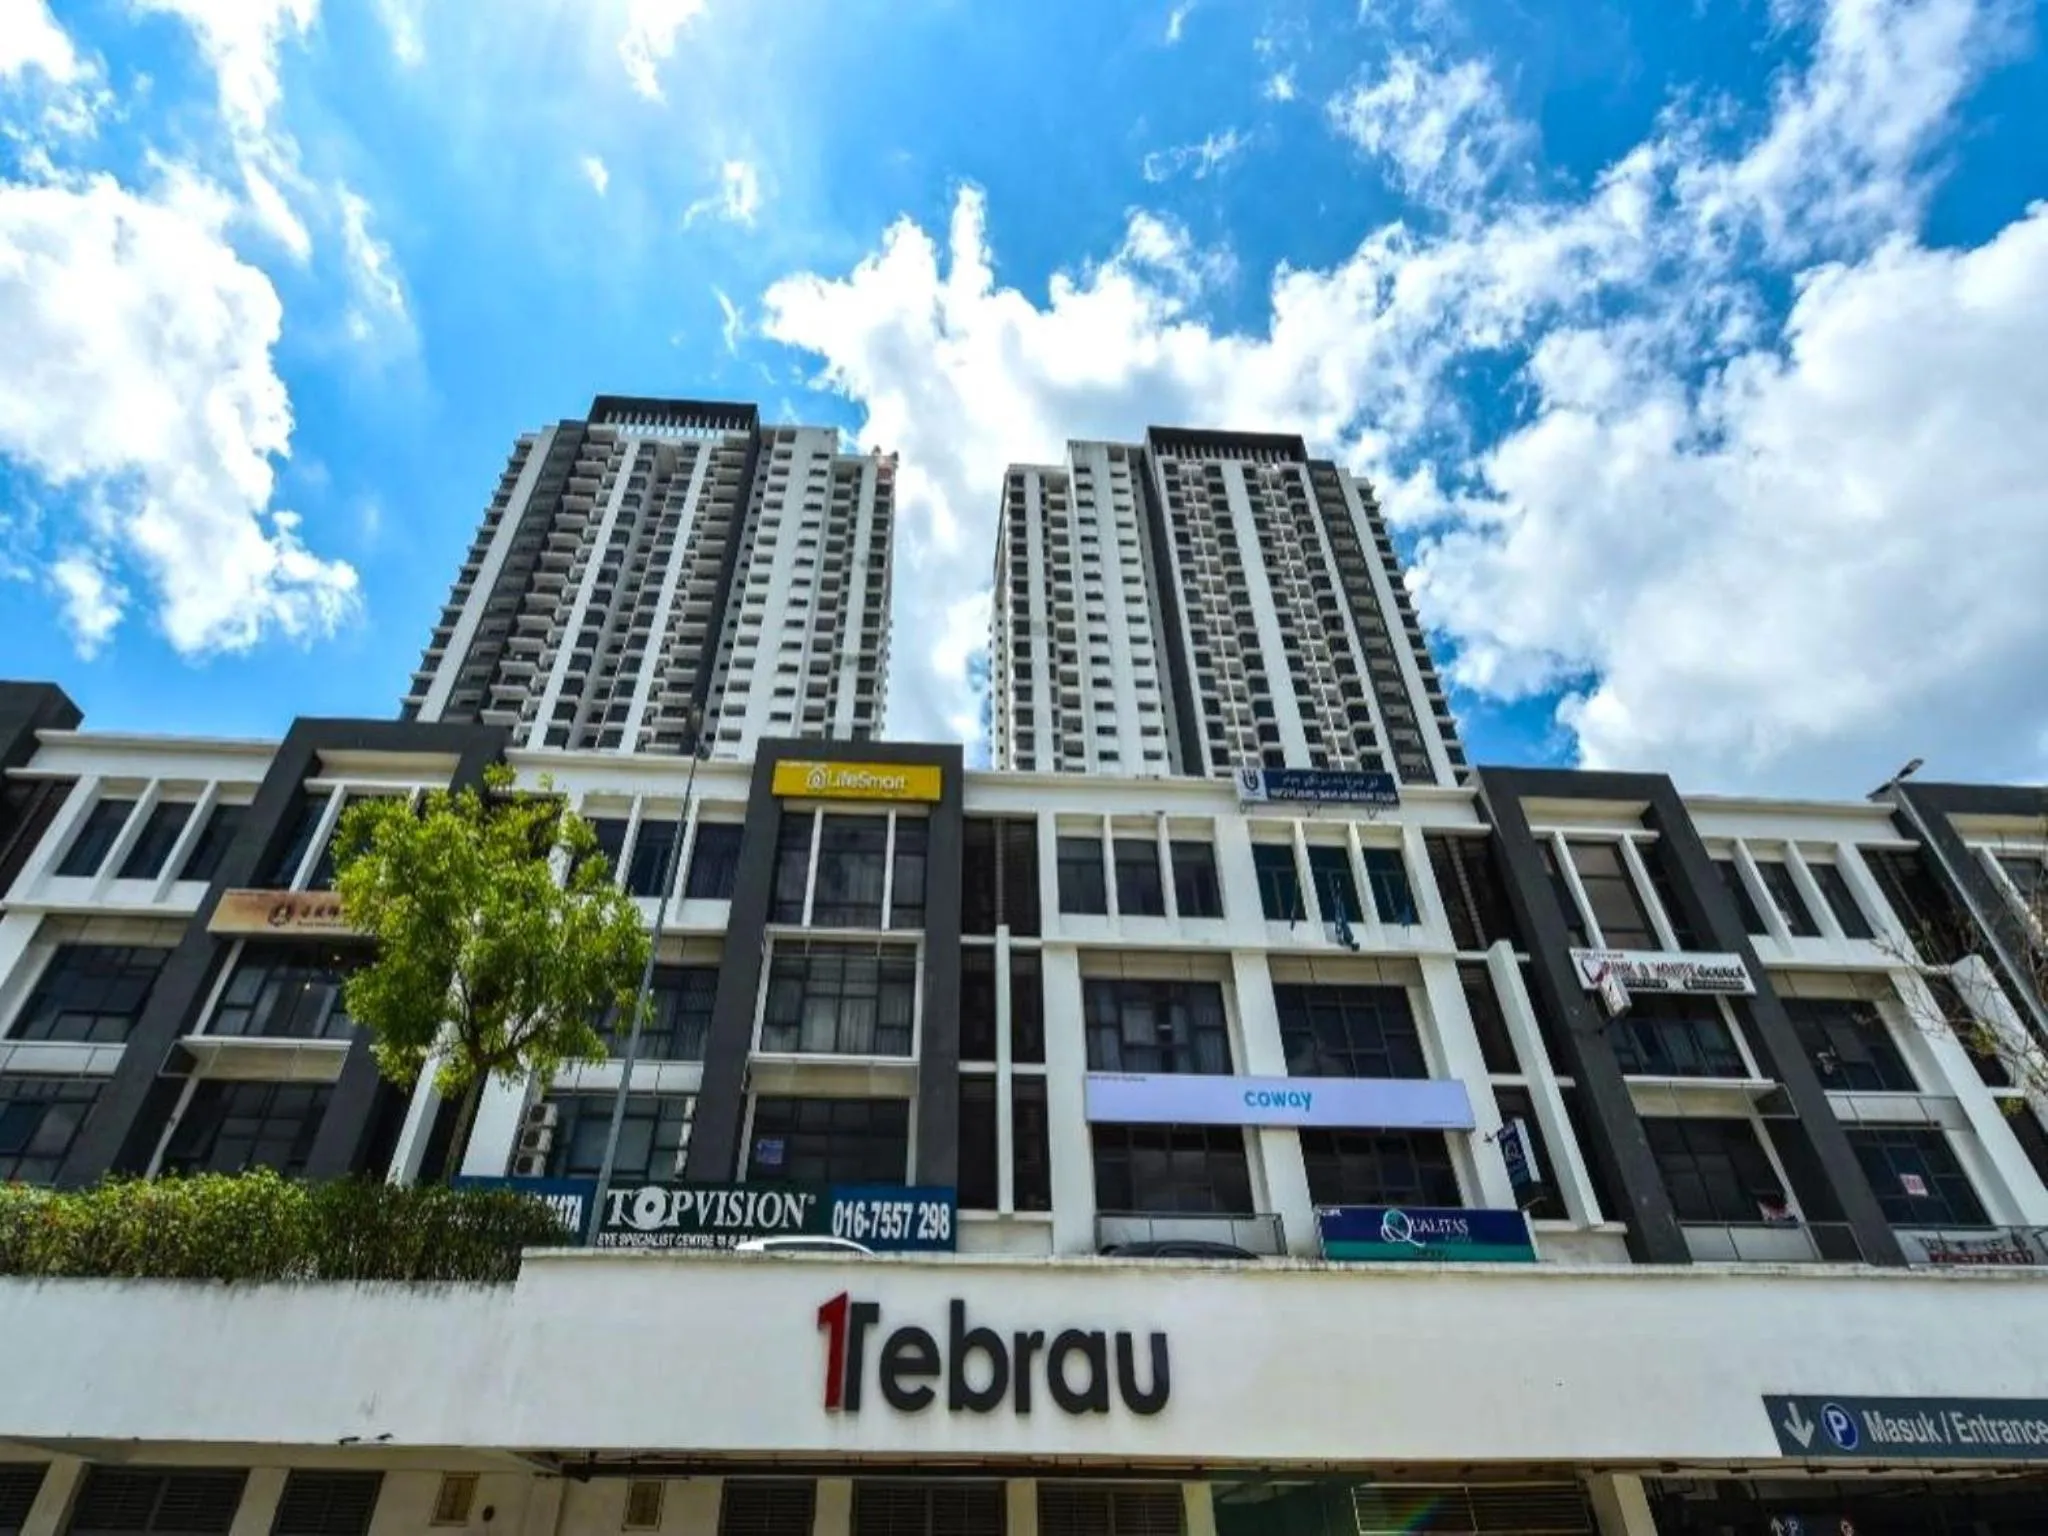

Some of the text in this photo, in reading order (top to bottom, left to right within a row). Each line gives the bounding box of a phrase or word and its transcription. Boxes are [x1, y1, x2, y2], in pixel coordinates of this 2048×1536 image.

[829, 769, 906, 790] LifeSmart
[1243, 1090, 1313, 1112] coway
[831, 1200, 951, 1240] 016-7557 298
[1381, 1208, 1469, 1247] QUALITAS
[619, 1233, 673, 1247] SPECIALIST
[676, 1234, 715, 1247] CENTRE
[817, 1290, 1171, 1416] 1Tebrau
[1862, 1410, 1942, 1443] Masuk
[1950, 1411, 2048, 1445] Entrance
